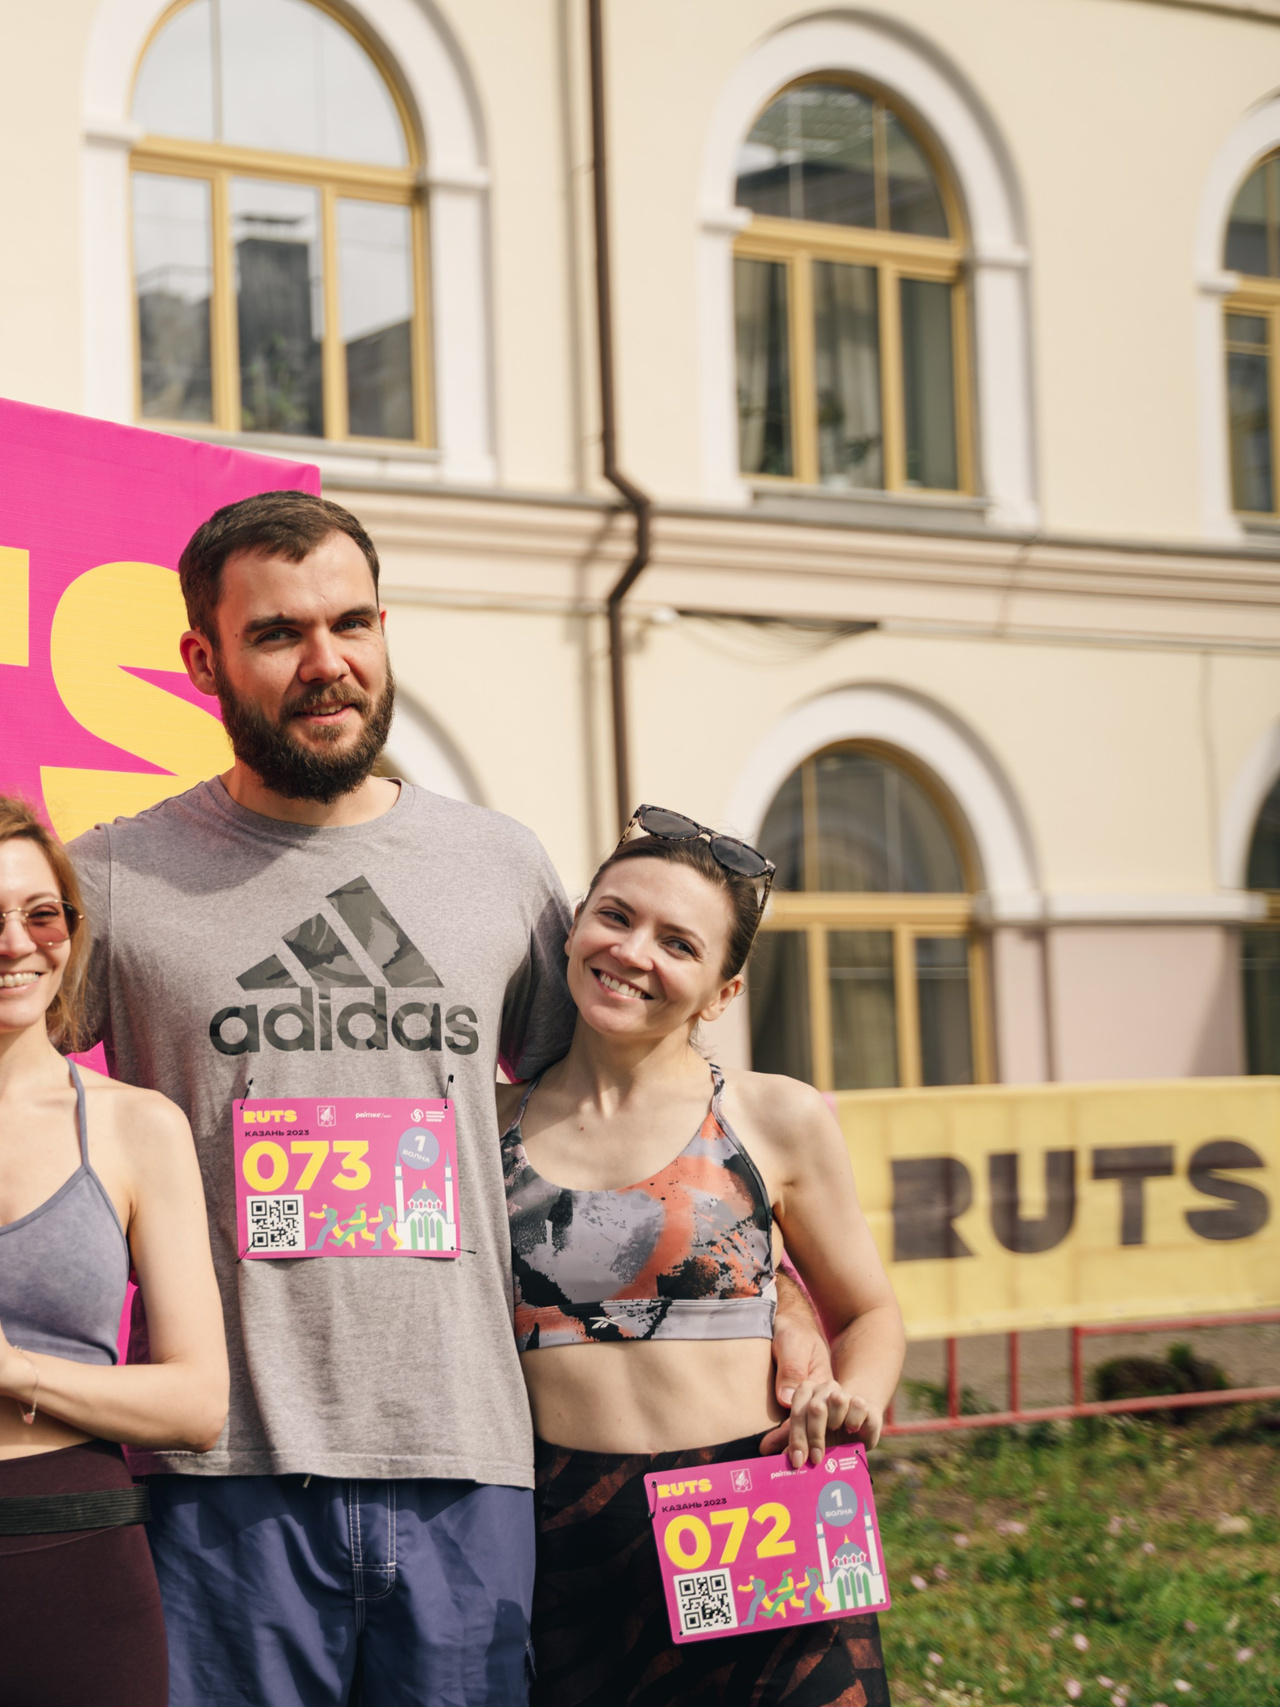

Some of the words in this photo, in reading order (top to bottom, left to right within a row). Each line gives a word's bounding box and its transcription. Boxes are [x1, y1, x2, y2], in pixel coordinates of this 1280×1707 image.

[209, 985, 479, 1056] adidas
[243, 1110, 297, 1124] RUTS
[414, 1135, 426, 1152] 1
[242, 1140, 371, 1192] 073
[402, 1149, 431, 1163] ВОЛНА
[891, 1140, 1270, 1262] RUTS
[656, 1478, 712, 1499] RUTS
[830, 1488, 843, 1508] 1
[661, 1501, 702, 1513] КАЗАНЬ
[703, 1497, 727, 1507] 2023
[825, 1508, 854, 1518] ВОЛНА
[664, 1502, 797, 1570] 072
